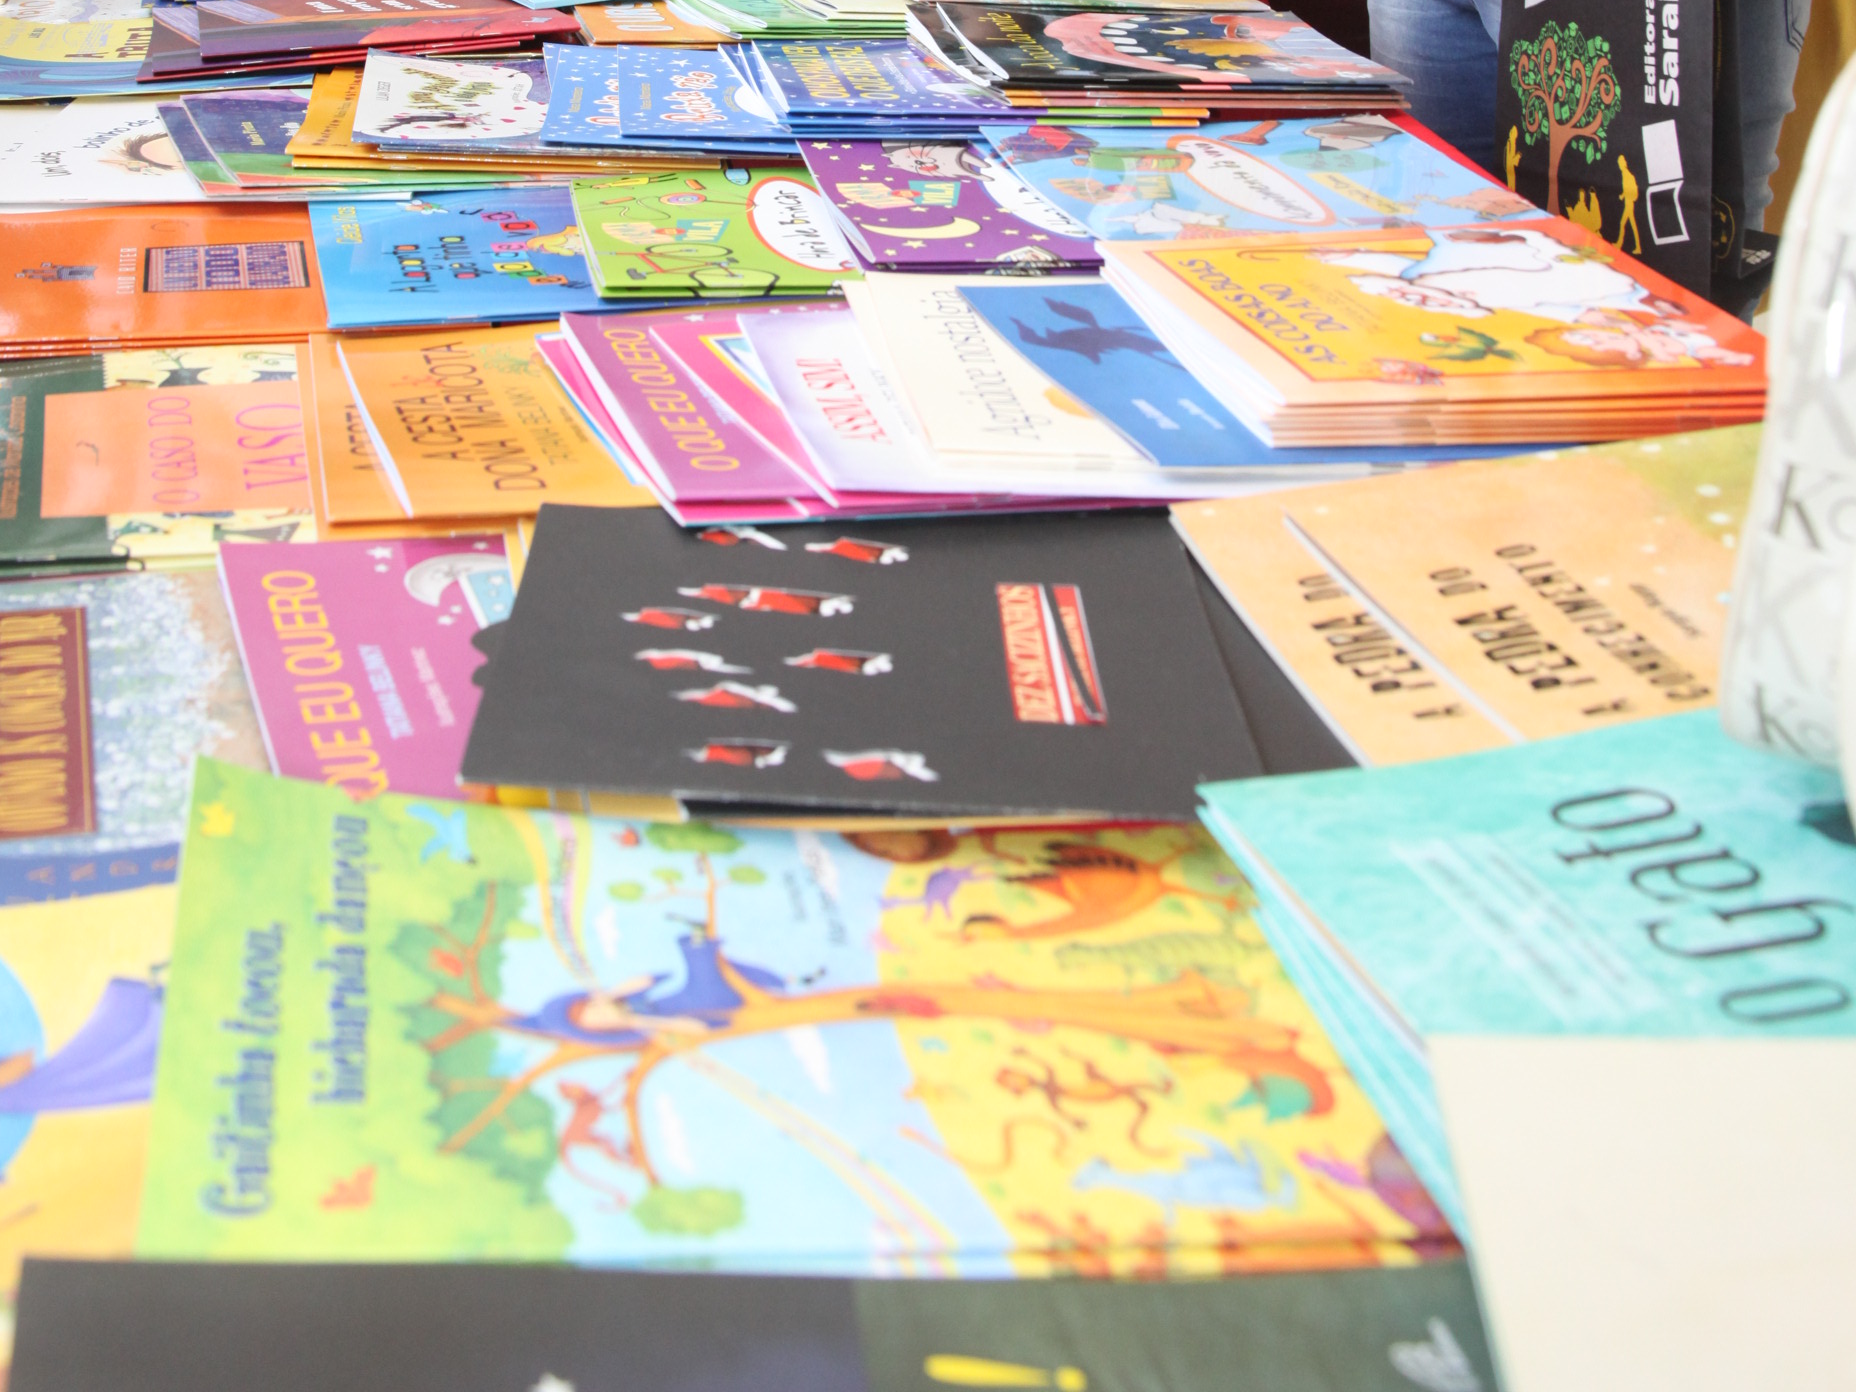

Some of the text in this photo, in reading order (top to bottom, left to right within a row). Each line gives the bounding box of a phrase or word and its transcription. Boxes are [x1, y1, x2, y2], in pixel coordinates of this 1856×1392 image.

[115, 26, 153, 59] TRUTA
[797, 74, 850, 99] OLHOS
[860, 92, 900, 100] O
[123, 119, 152, 132] de
[459, 208, 538, 239] voar
[118, 247, 137, 272] RITER
[204, 247, 241, 288] TODO
[381, 244, 444, 292] A Lagarta
[428, 236, 494, 280] que tinha
[480, 241, 531, 260] de
[1178, 256, 1348, 366] AS COISAS BOAS
[1302, 312, 1349, 334] DO
[392, 395, 464, 445] CESTA
[420, 341, 547, 491] DONA MARICOTA
[603, 328, 740, 471] O QUE EU QUERO
[147, 396, 200, 505] O CASO DO
[235, 403, 309, 491] VASO
[422, 448, 475, 461] A
[1428, 566, 1489, 598] DO
[1494, 542, 1714, 702] CONHECIMENTO
[1452, 603, 1599, 692] PEDRA
[261, 569, 389, 800] QUE EU QUERO
[1014, 685, 1061, 722] DEZ
[1582, 698, 1631, 716] A
[1550, 787, 1856, 959] gato
